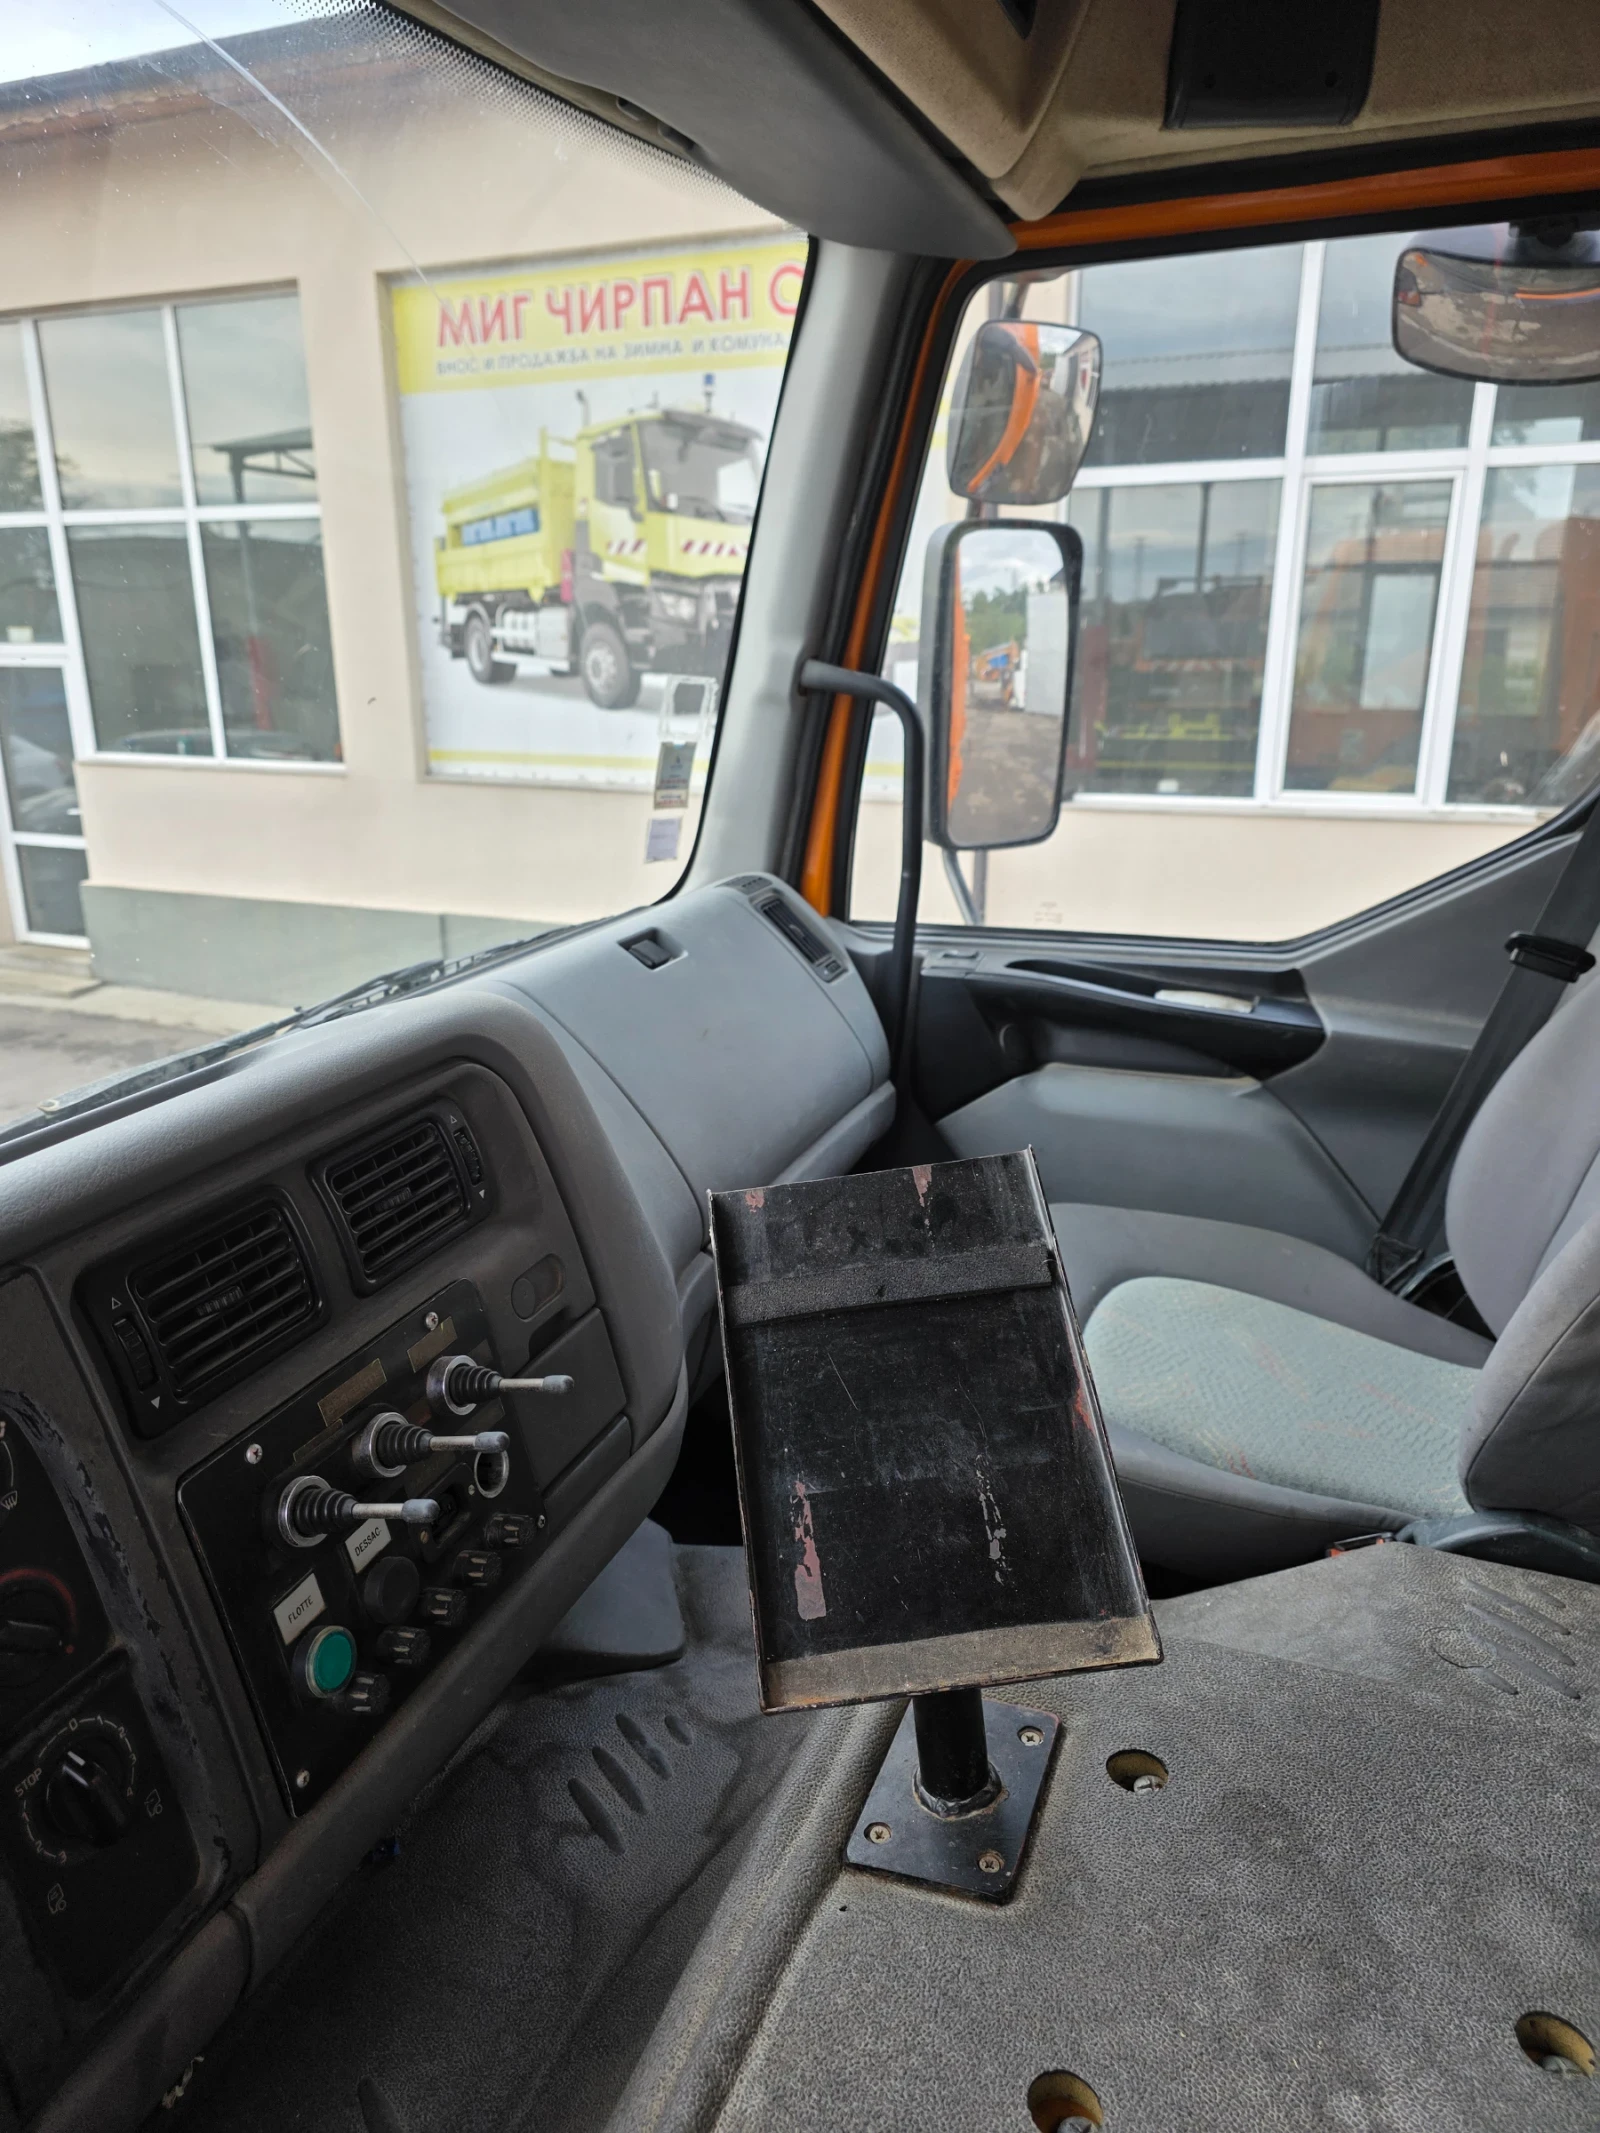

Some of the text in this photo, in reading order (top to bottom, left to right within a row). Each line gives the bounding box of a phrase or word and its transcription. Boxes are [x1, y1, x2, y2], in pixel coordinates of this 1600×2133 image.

[437, 292, 530, 348] МИГ
[544, 268, 750, 336] ЧИРПАН
[497, 347, 590, 370] ПРОДАЖБА
[595, 345, 617, 360] НА
[624, 339, 684, 358] ЗИМНА
[692, 336, 706, 353] И
[287, 1594, 314, 1624] FLOTTE
[14, 1767, 43, 1798] STOP
